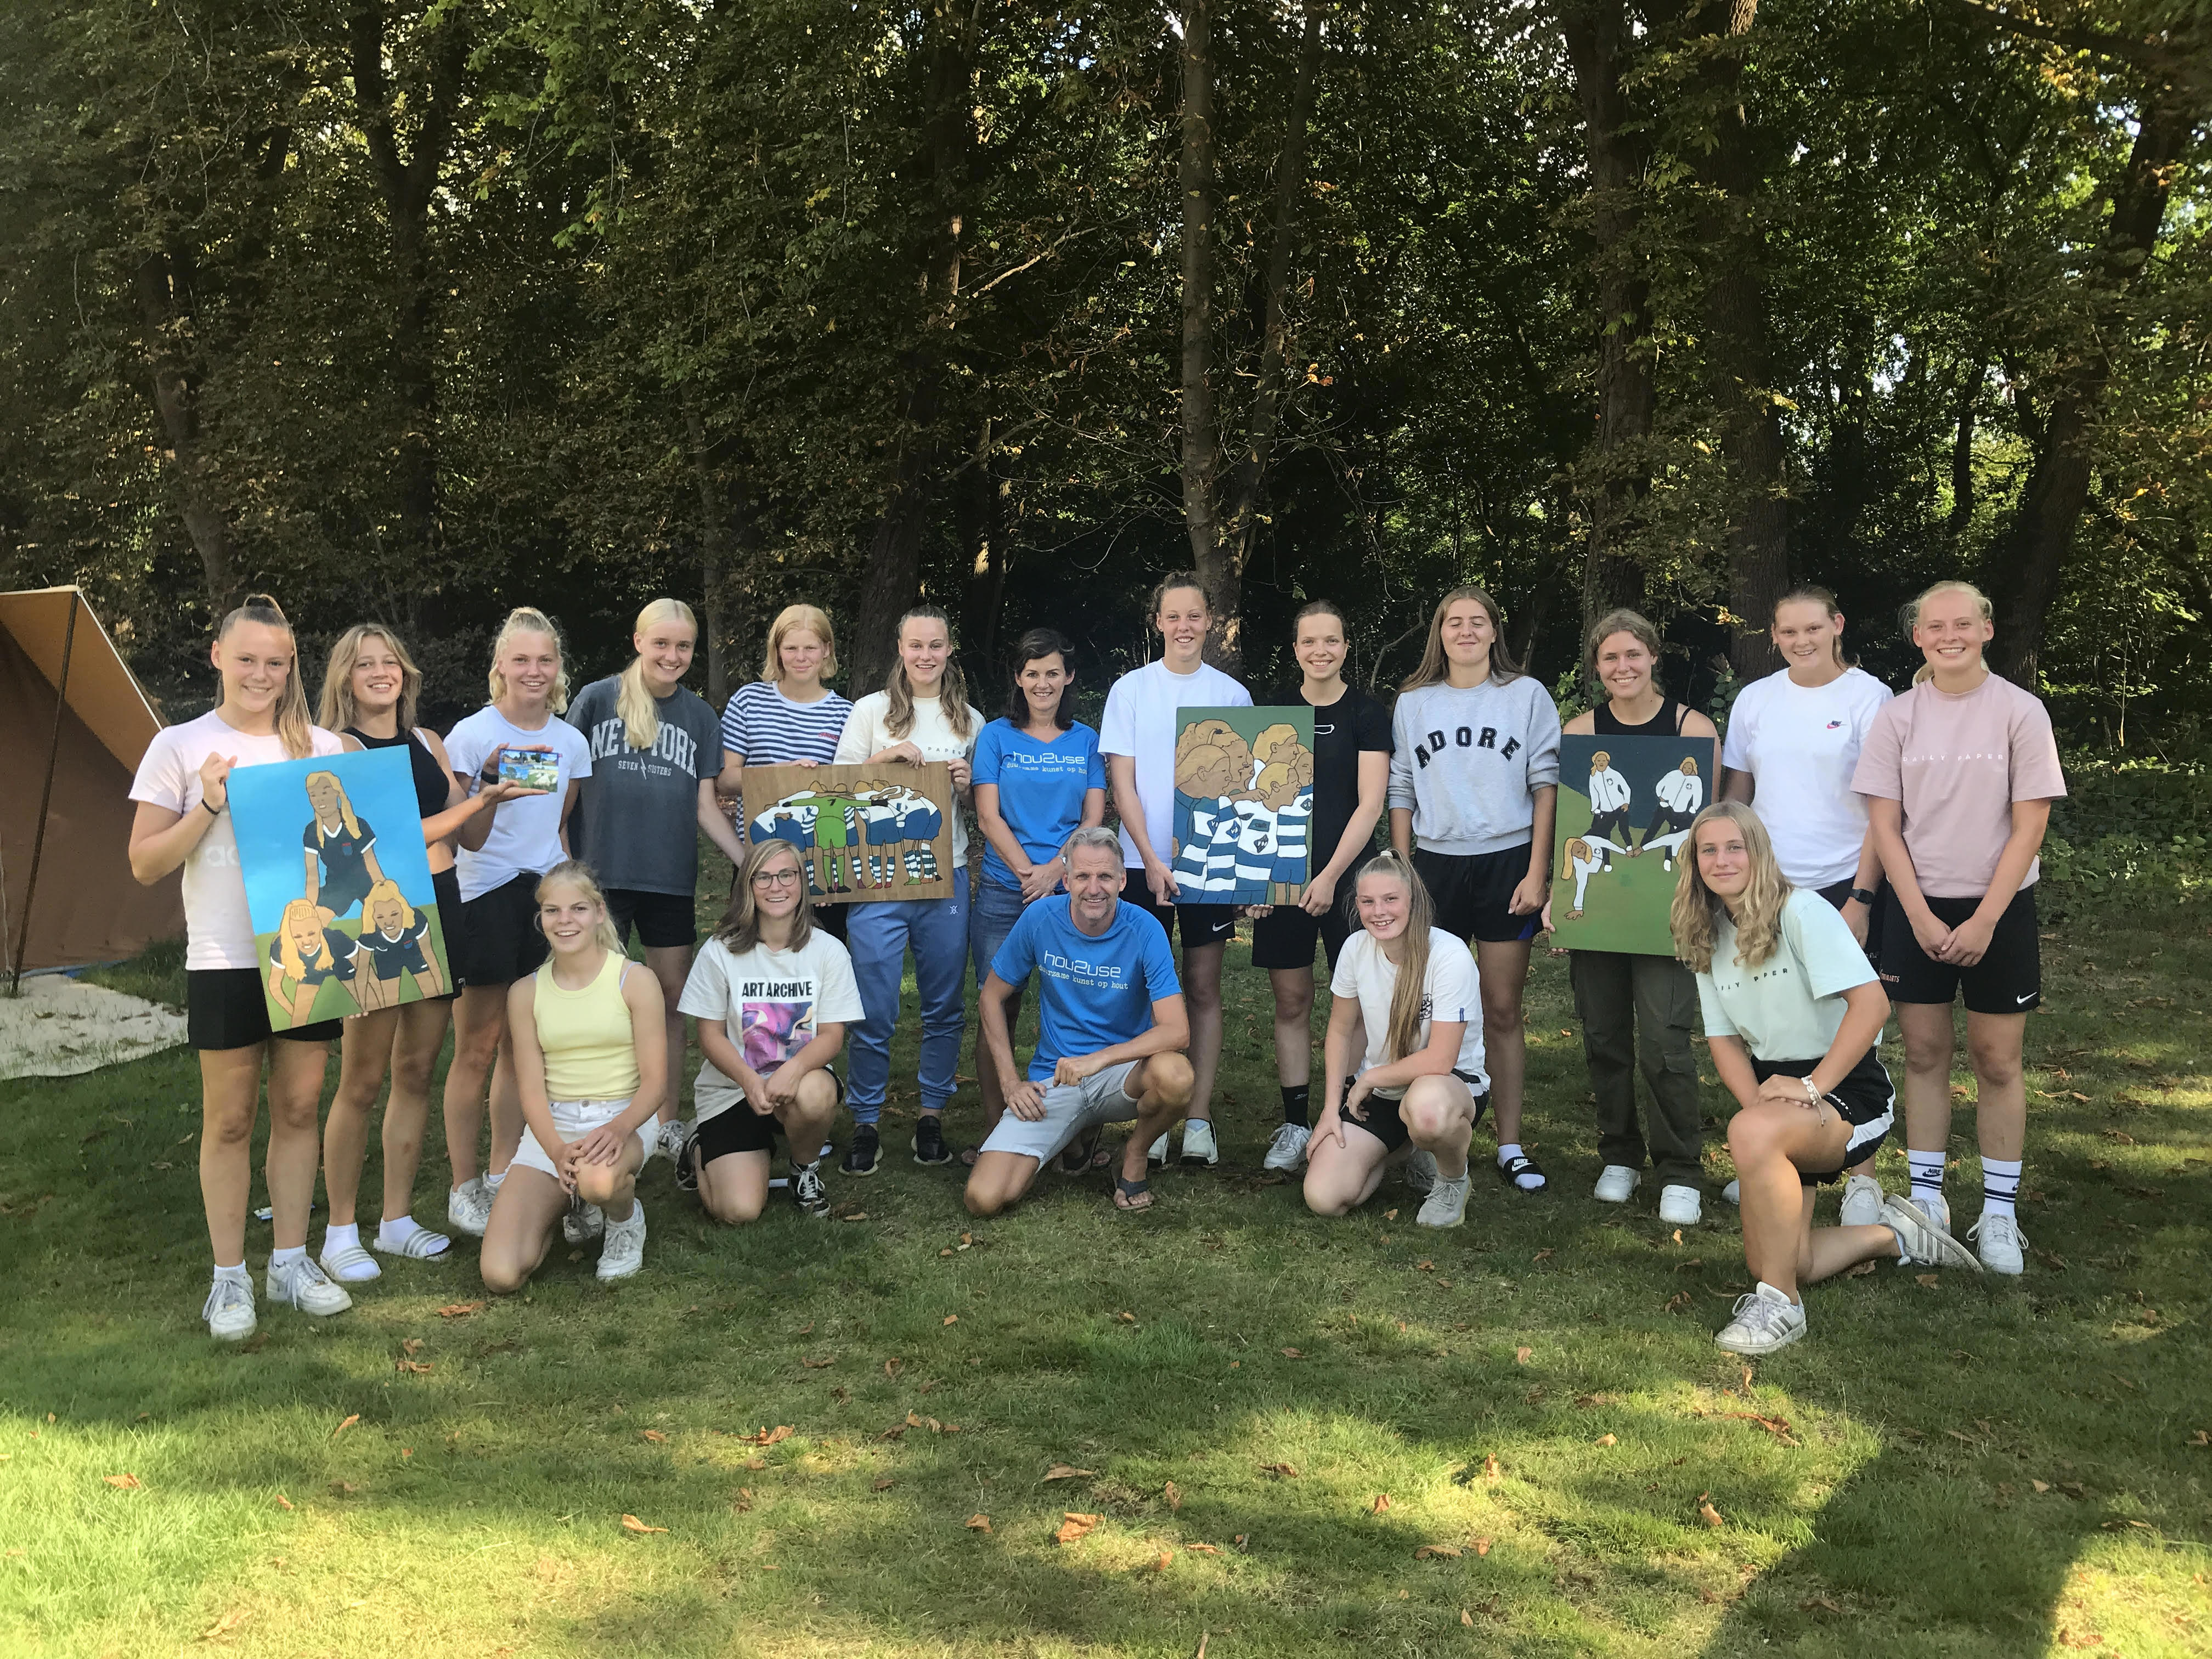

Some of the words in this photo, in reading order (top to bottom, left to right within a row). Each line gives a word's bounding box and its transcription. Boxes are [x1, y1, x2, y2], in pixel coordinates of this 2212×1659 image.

[1414, 726, 1521, 770] ADORE
[1013, 751, 1085, 764] hou2use
[618, 760, 639, 771] SEVEN
[648, 764, 672, 777] SISTERS
[1044, 950, 1121, 978] hou2use
[742, 982, 765, 997] ART
[766, 981, 812, 997] ARCHIVE
[1073, 975, 1094, 986] kunst
[1111, 981, 1128, 990] hout
[1514, 1158, 1528, 1166] NIKE
